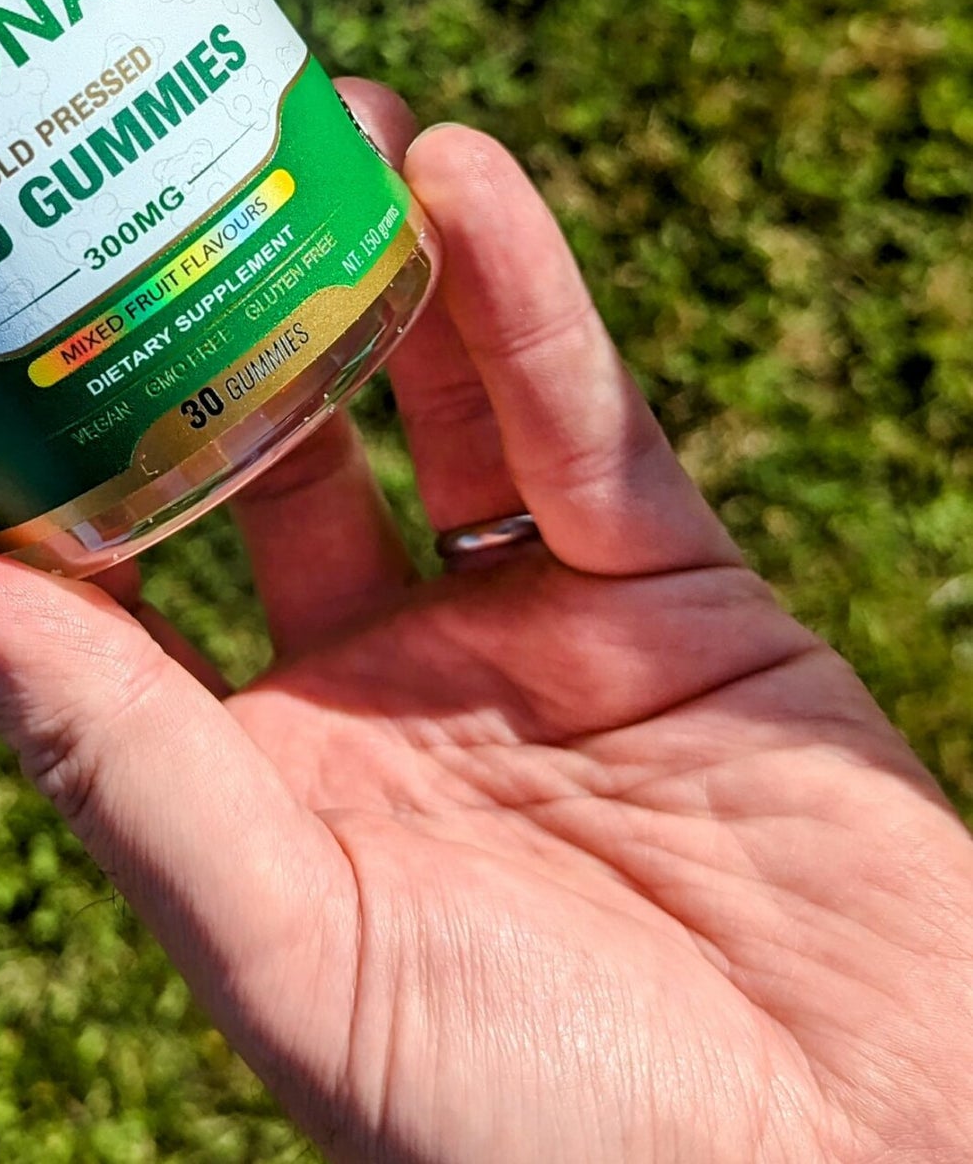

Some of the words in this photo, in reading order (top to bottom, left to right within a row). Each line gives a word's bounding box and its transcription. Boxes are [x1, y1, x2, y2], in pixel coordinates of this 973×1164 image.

[18, 23, 247, 228] GUMMIES
[35, 45, 153, 147] PRESSED
[59, 313, 125, 366] MIXED
[125, 270, 181, 321] FRUIT
[179, 196, 268, 277] FLAVOURS
[83, 185, 186, 271] 300MG
[359, 227, 381, 257] 150
[377, 204, 400, 239] grams
[72, 400, 133, 446] VEGAN
[144, 363, 187, 398] GMO
[187, 328, 235, 368] FREE
[244, 265, 304, 321] GLUTEN
[301, 231, 338, 270] FREE
[86, 327, 172, 396] DIETARY
[174, 224, 296, 333] SUPPLEMENT
[181, 387, 225, 429] 30
[225, 322, 310, 401] GUMMIES
